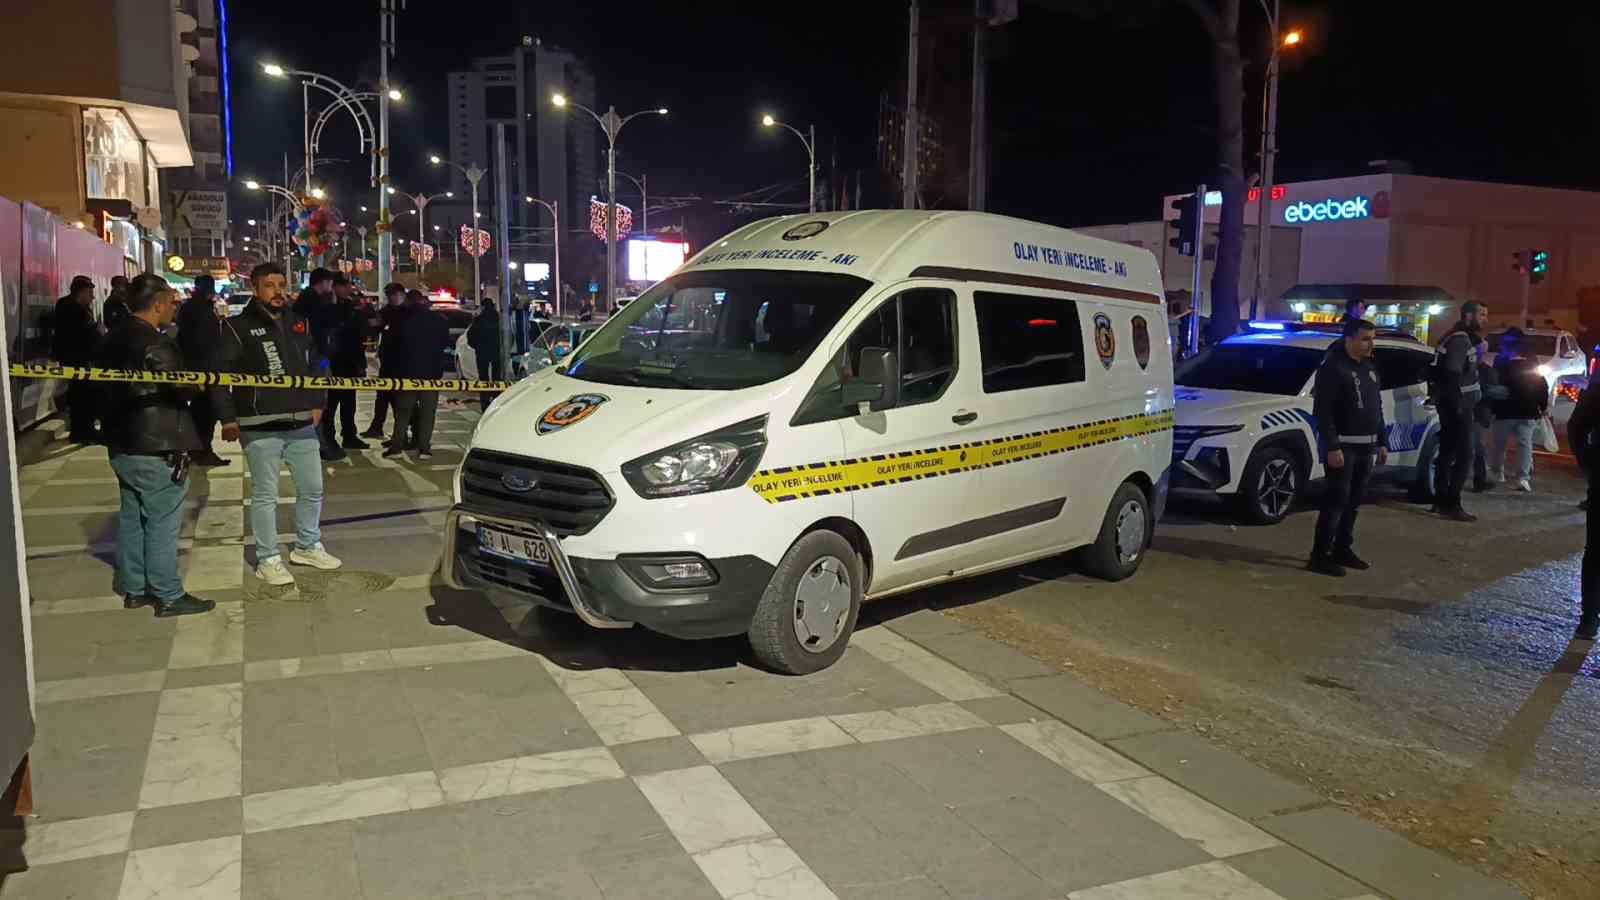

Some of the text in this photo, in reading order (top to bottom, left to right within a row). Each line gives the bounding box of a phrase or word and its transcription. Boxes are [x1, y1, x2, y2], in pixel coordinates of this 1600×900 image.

[1284, 196, 1368, 223] ebebek
[753, 247, 824, 261] İNCELEME
[1013, 241, 1039, 262] OLAY
[1040, 247, 1062, 266] YERİ
[1064, 251, 1107, 273] İNCELEME
[877, 464, 896, 475] OLAY
[913, 456, 944, 470] İNCELEME
[752, 479, 778, 494] OLAY
[780, 477, 802, 489] YERİ
[500, 534, 515, 554] AL
[523, 540, 548, 560] 628
